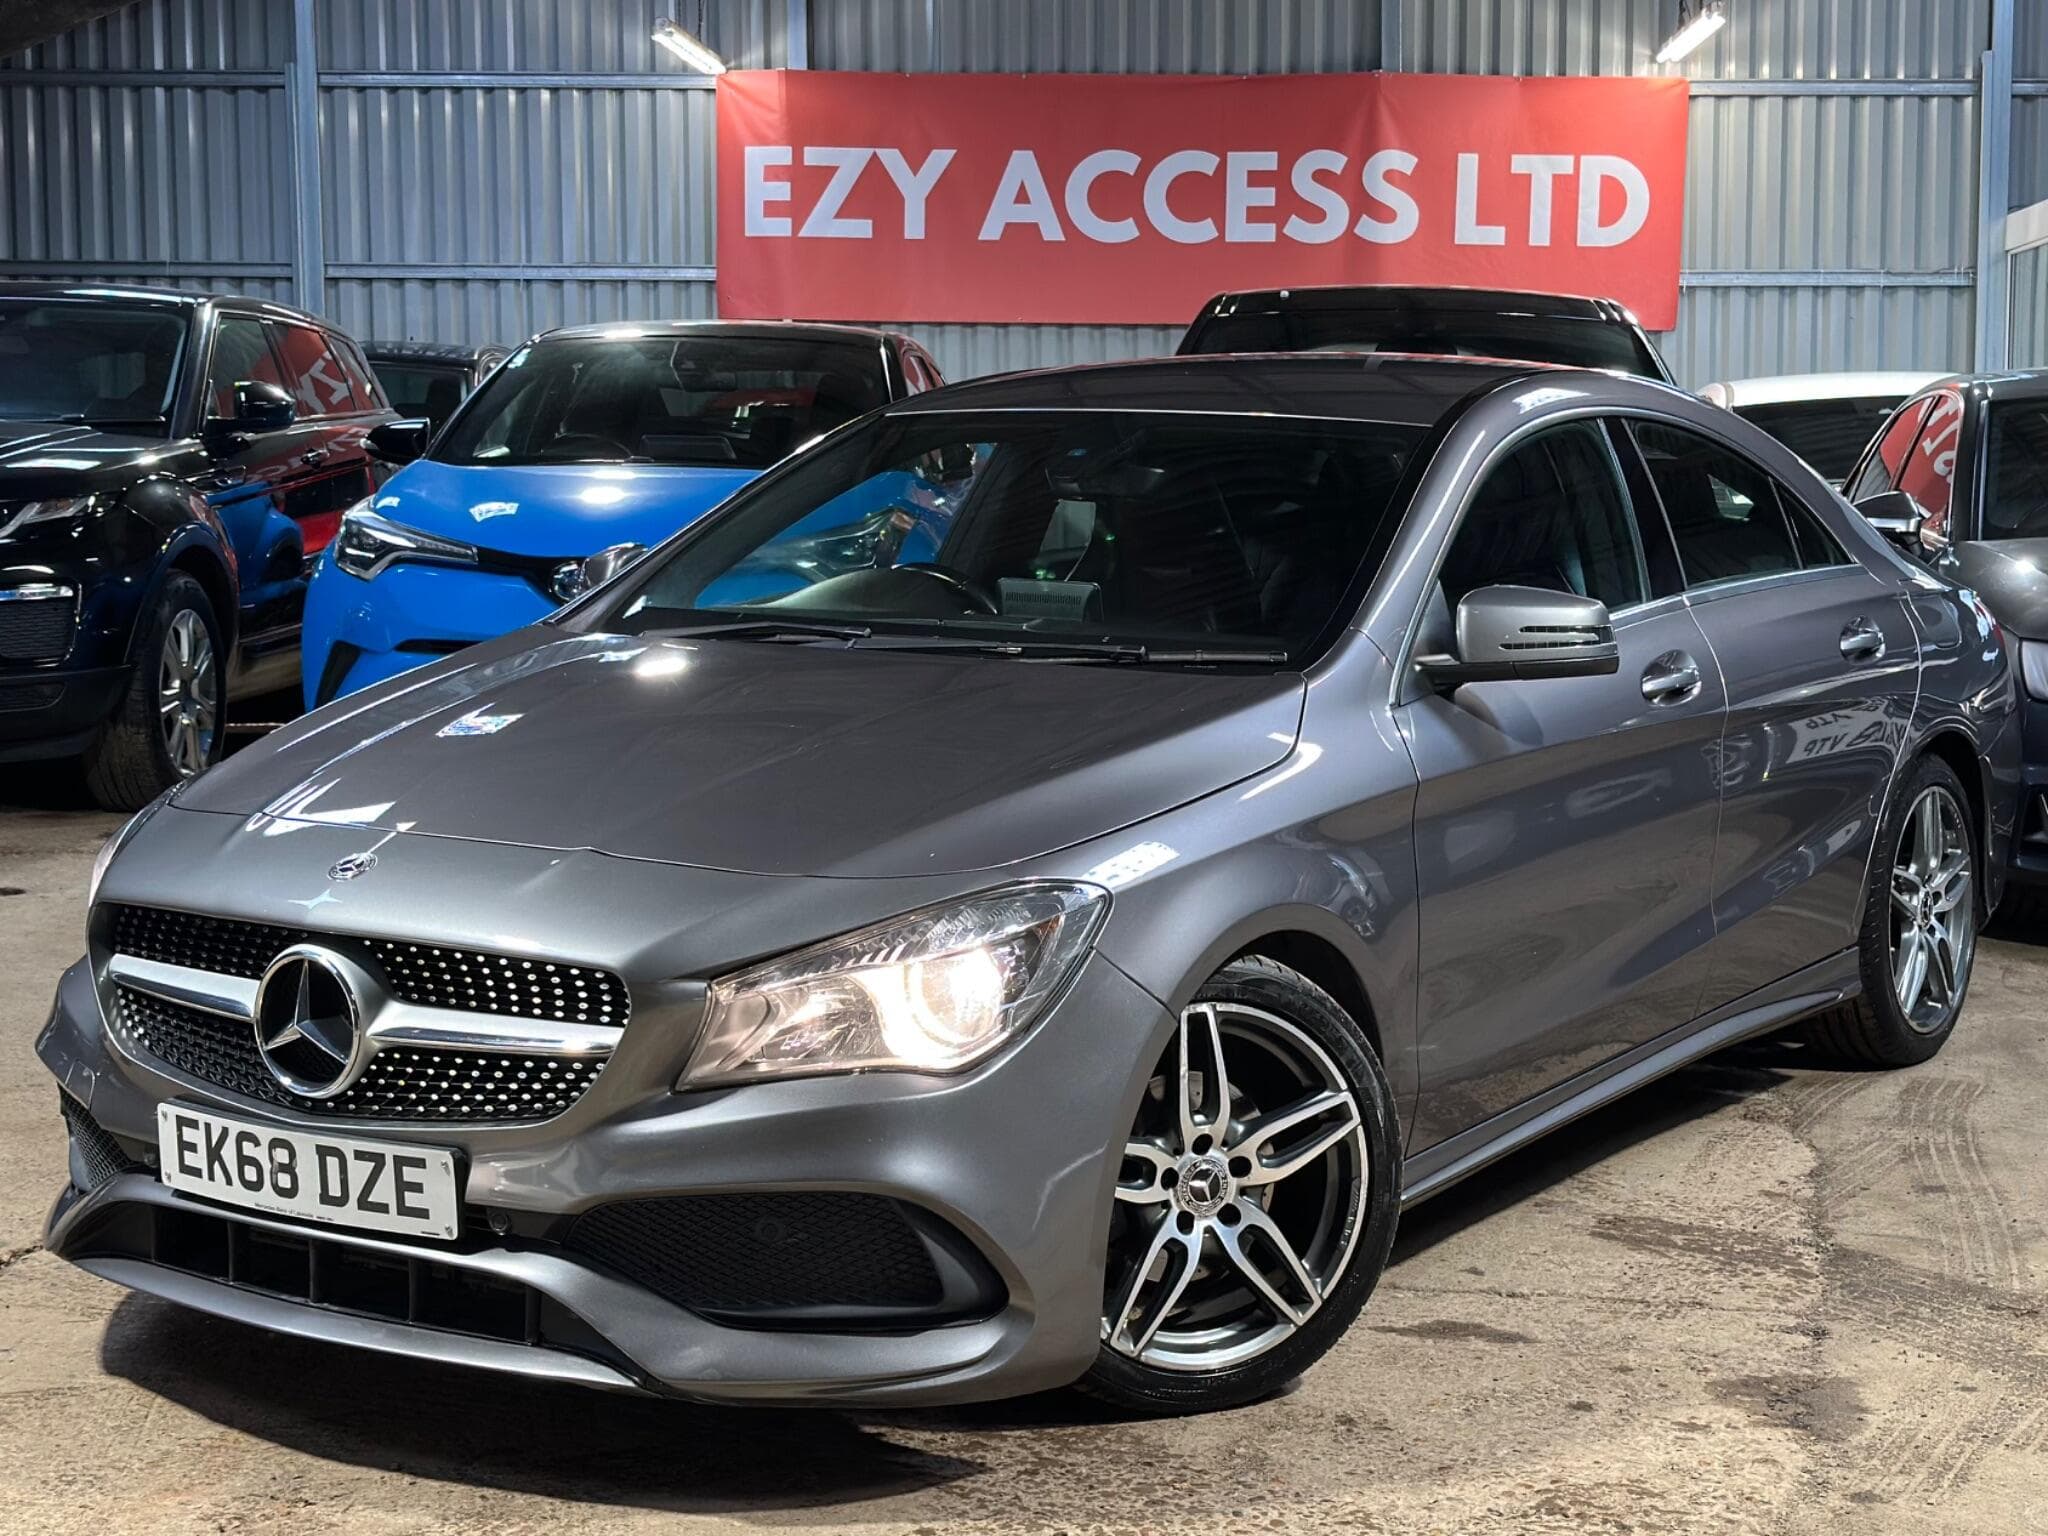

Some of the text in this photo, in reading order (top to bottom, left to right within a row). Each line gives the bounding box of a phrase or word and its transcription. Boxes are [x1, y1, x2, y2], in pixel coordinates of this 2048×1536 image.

[744, 145, 1651, 248] EZY ACCESS LTD
[175, 1114, 431, 1221] EK68 DZE
